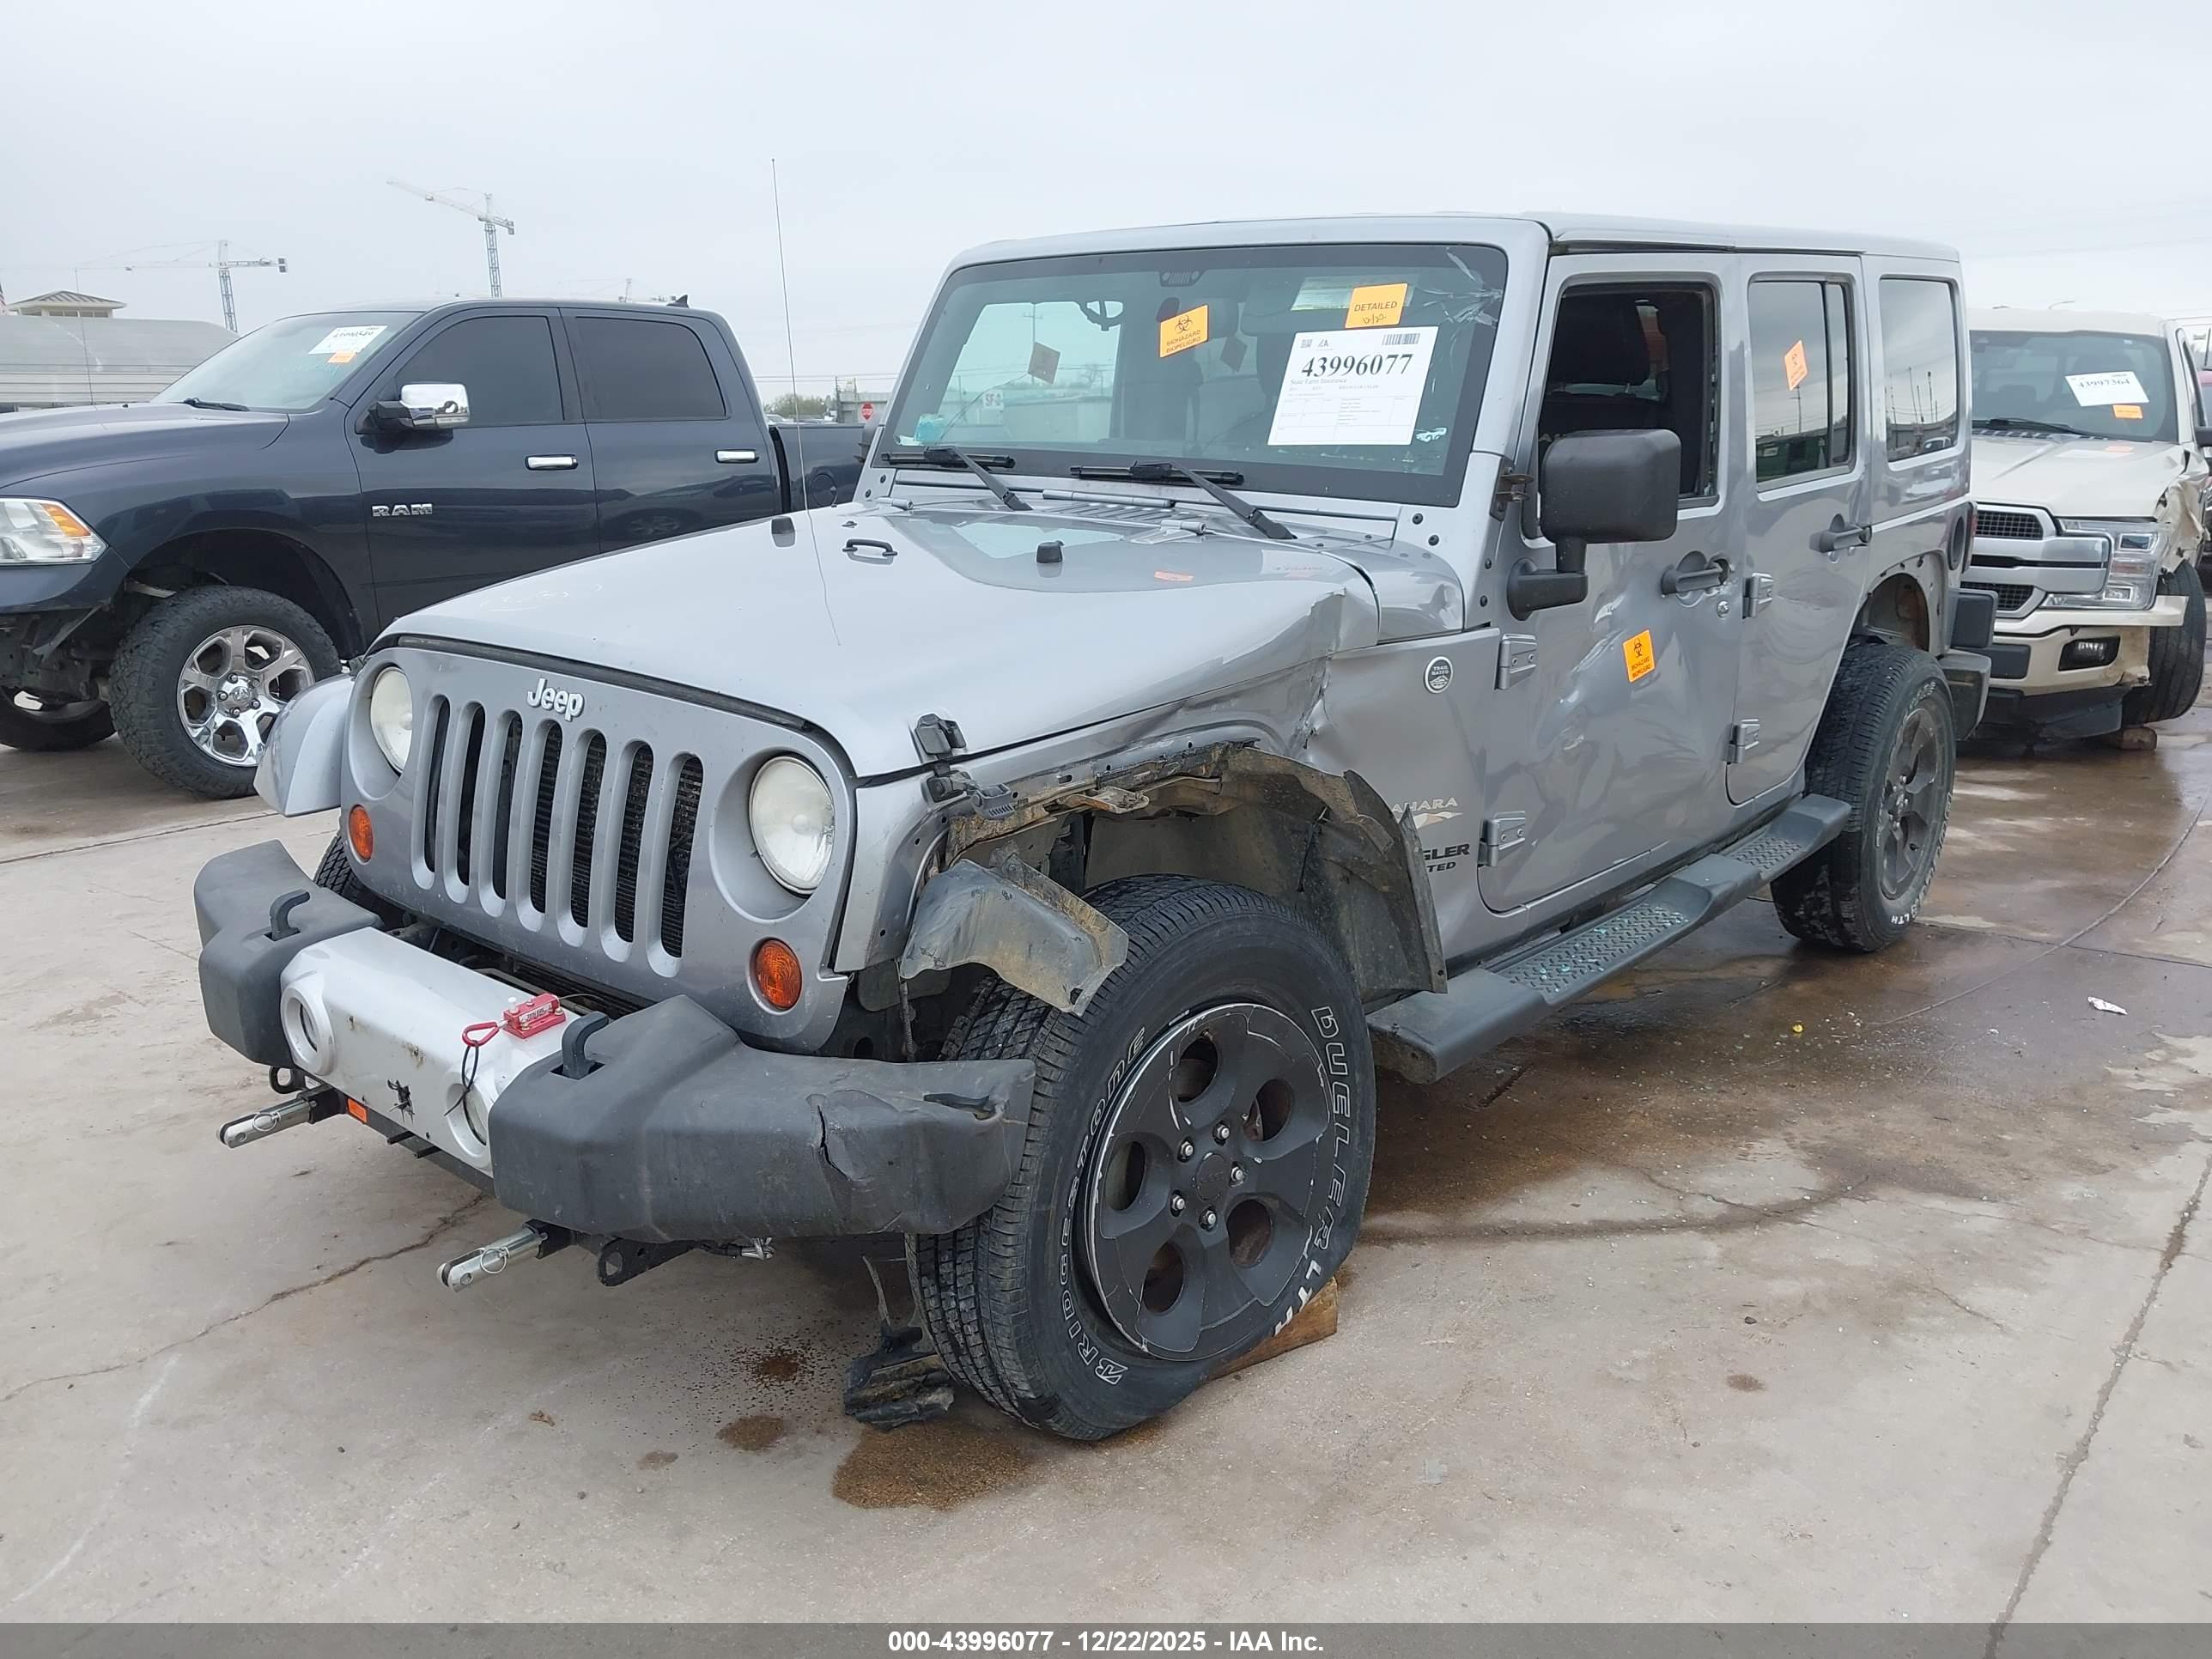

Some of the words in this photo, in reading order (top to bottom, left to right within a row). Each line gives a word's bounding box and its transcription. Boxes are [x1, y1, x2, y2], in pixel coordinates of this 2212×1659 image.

[1353, 301, 1398, 312] DETAILED
[1166, 330, 1201, 346] BIOHAZARD
[1301, 353, 1413, 378] 43996077
[372, 503, 433, 517] RAM
[527, 678, 584, 721] Jeep
[1391, 797, 1458, 812] AHARA
[1310, 1006, 1351, 1251] DUELER
[1060, 1026, 1146, 1385] BRIDGESTONE
